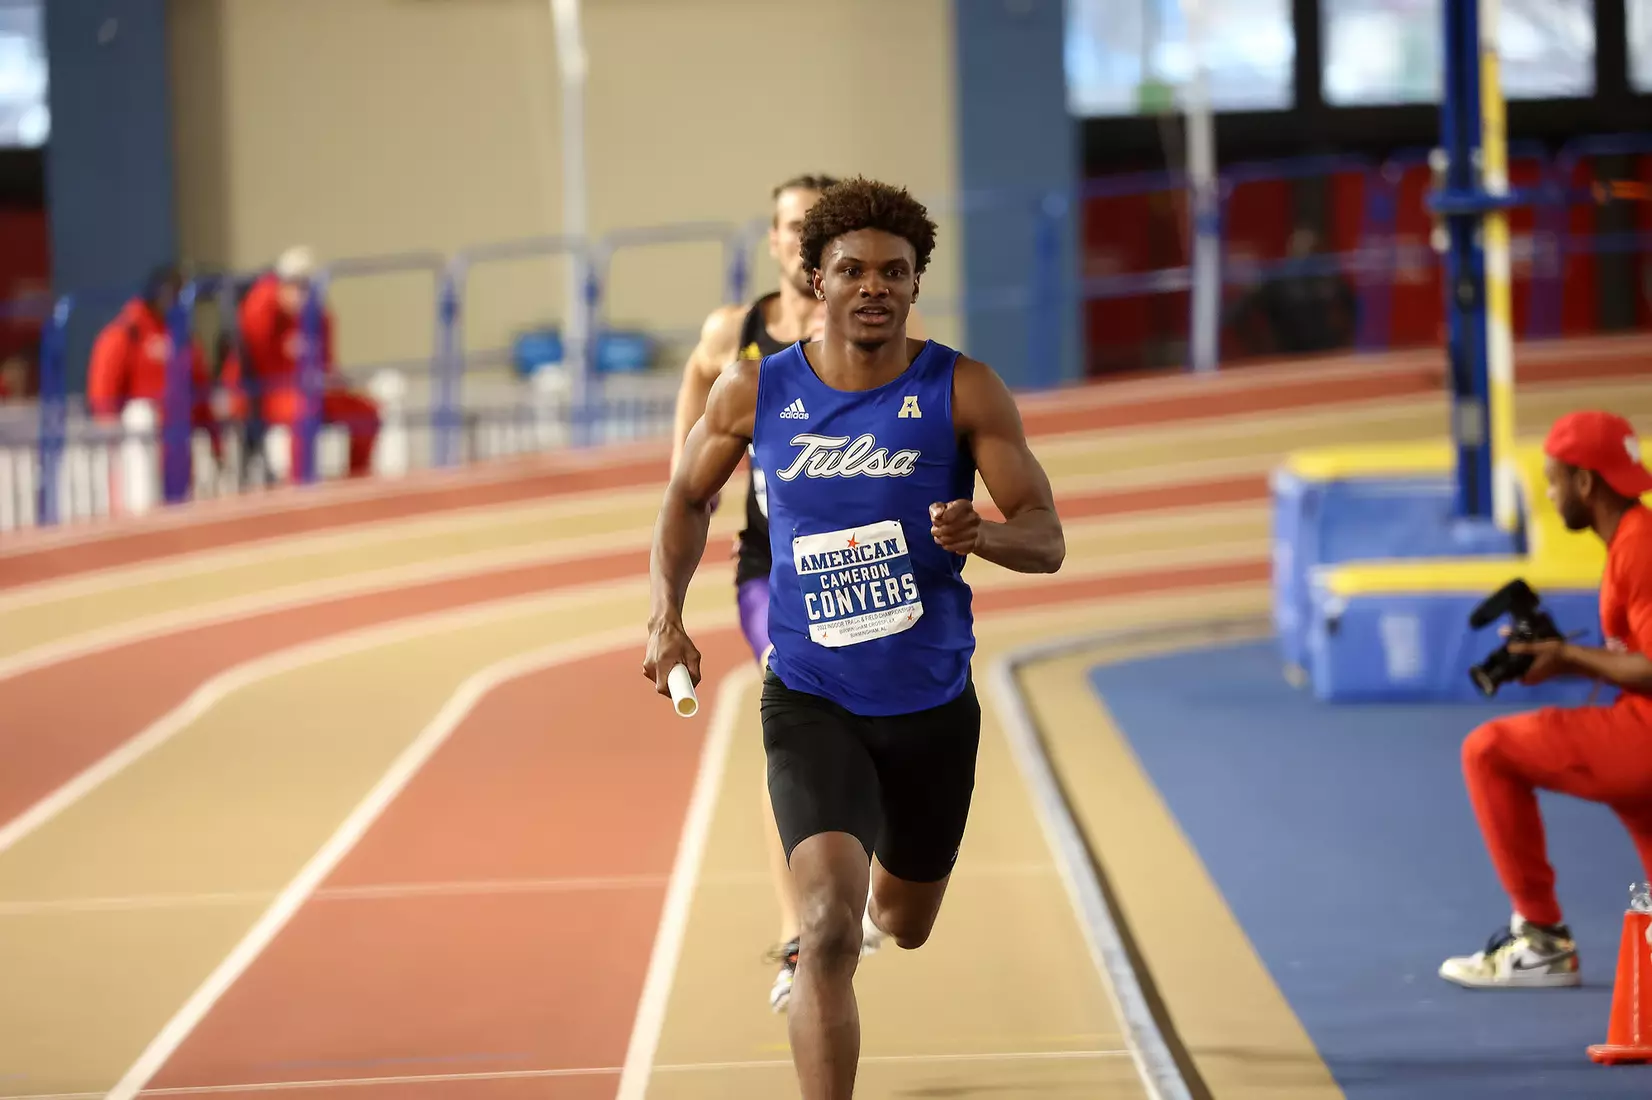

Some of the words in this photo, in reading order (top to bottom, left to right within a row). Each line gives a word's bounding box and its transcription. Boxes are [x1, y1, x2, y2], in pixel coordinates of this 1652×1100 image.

[779, 410, 809, 420] adidas
[776, 433, 921, 481] Tulsa
[800, 538, 900, 571] AMERICAN
[820, 562, 890, 589] CAMERON
[804, 573, 918, 620] CONYERS
[827, 621, 845, 629] INDOOR
[845, 618, 861, 626] TRACK
[878, 605, 915, 618] CHAMPIONSHIPS
